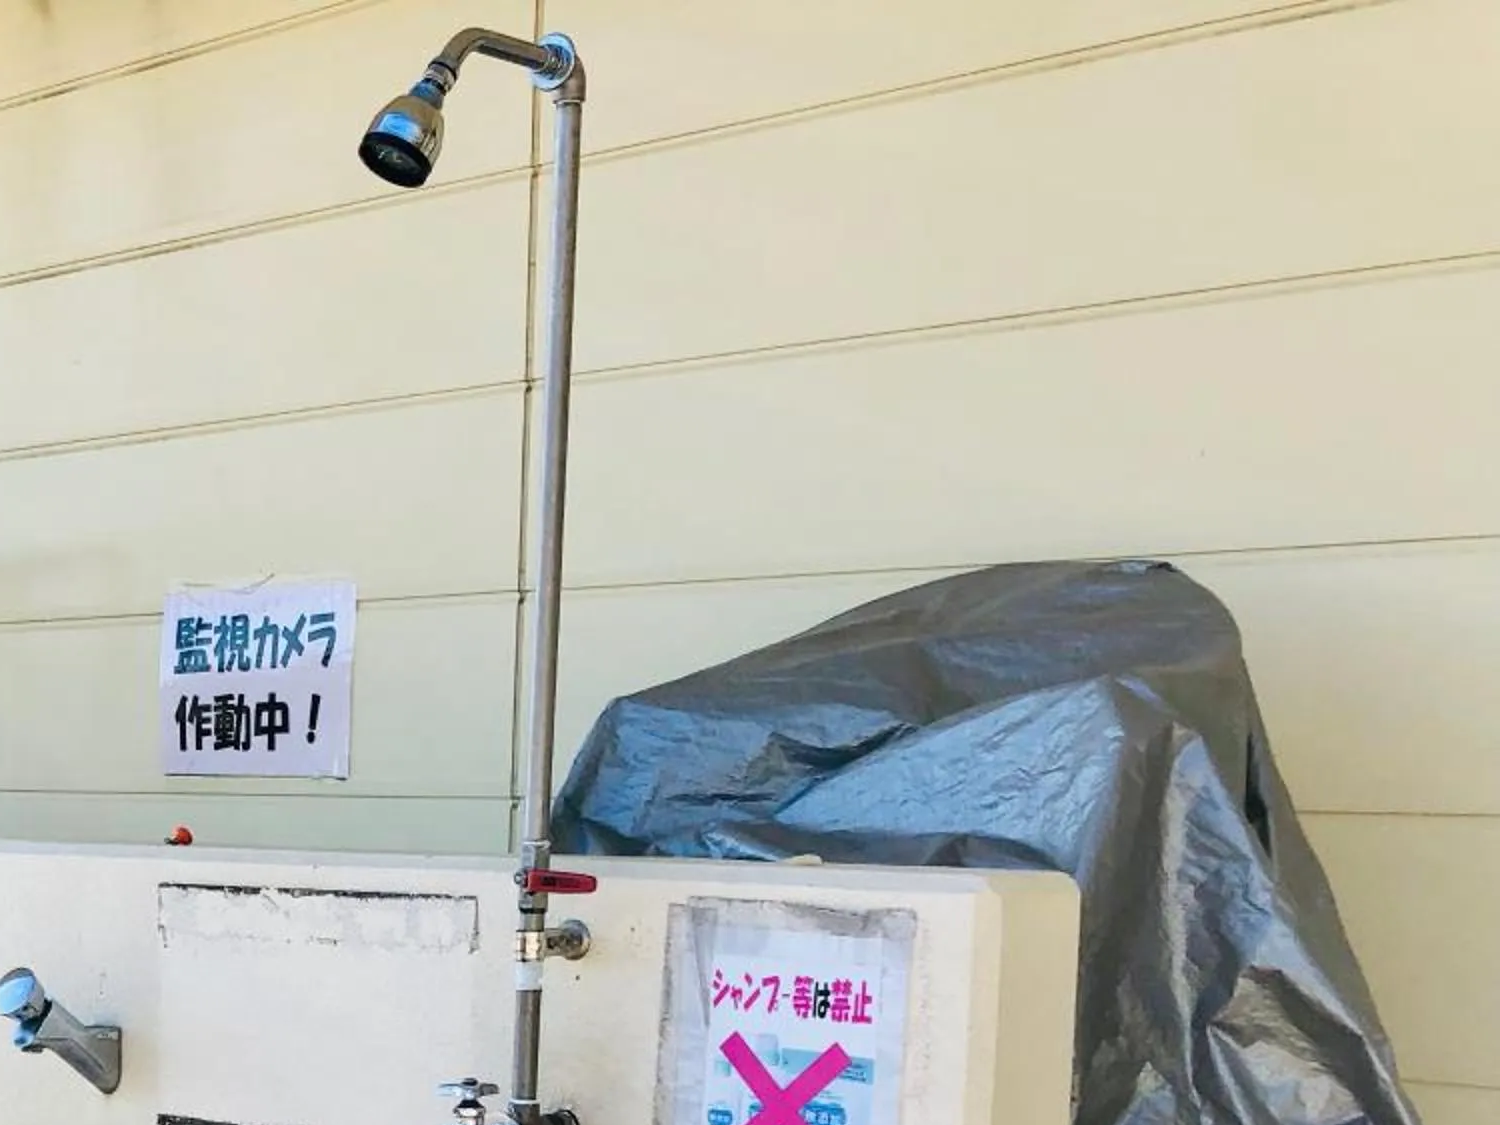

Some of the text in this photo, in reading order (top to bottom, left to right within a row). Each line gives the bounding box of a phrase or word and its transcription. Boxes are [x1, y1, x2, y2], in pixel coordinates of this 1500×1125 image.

[173, 612, 337, 674] 監視カメラ
